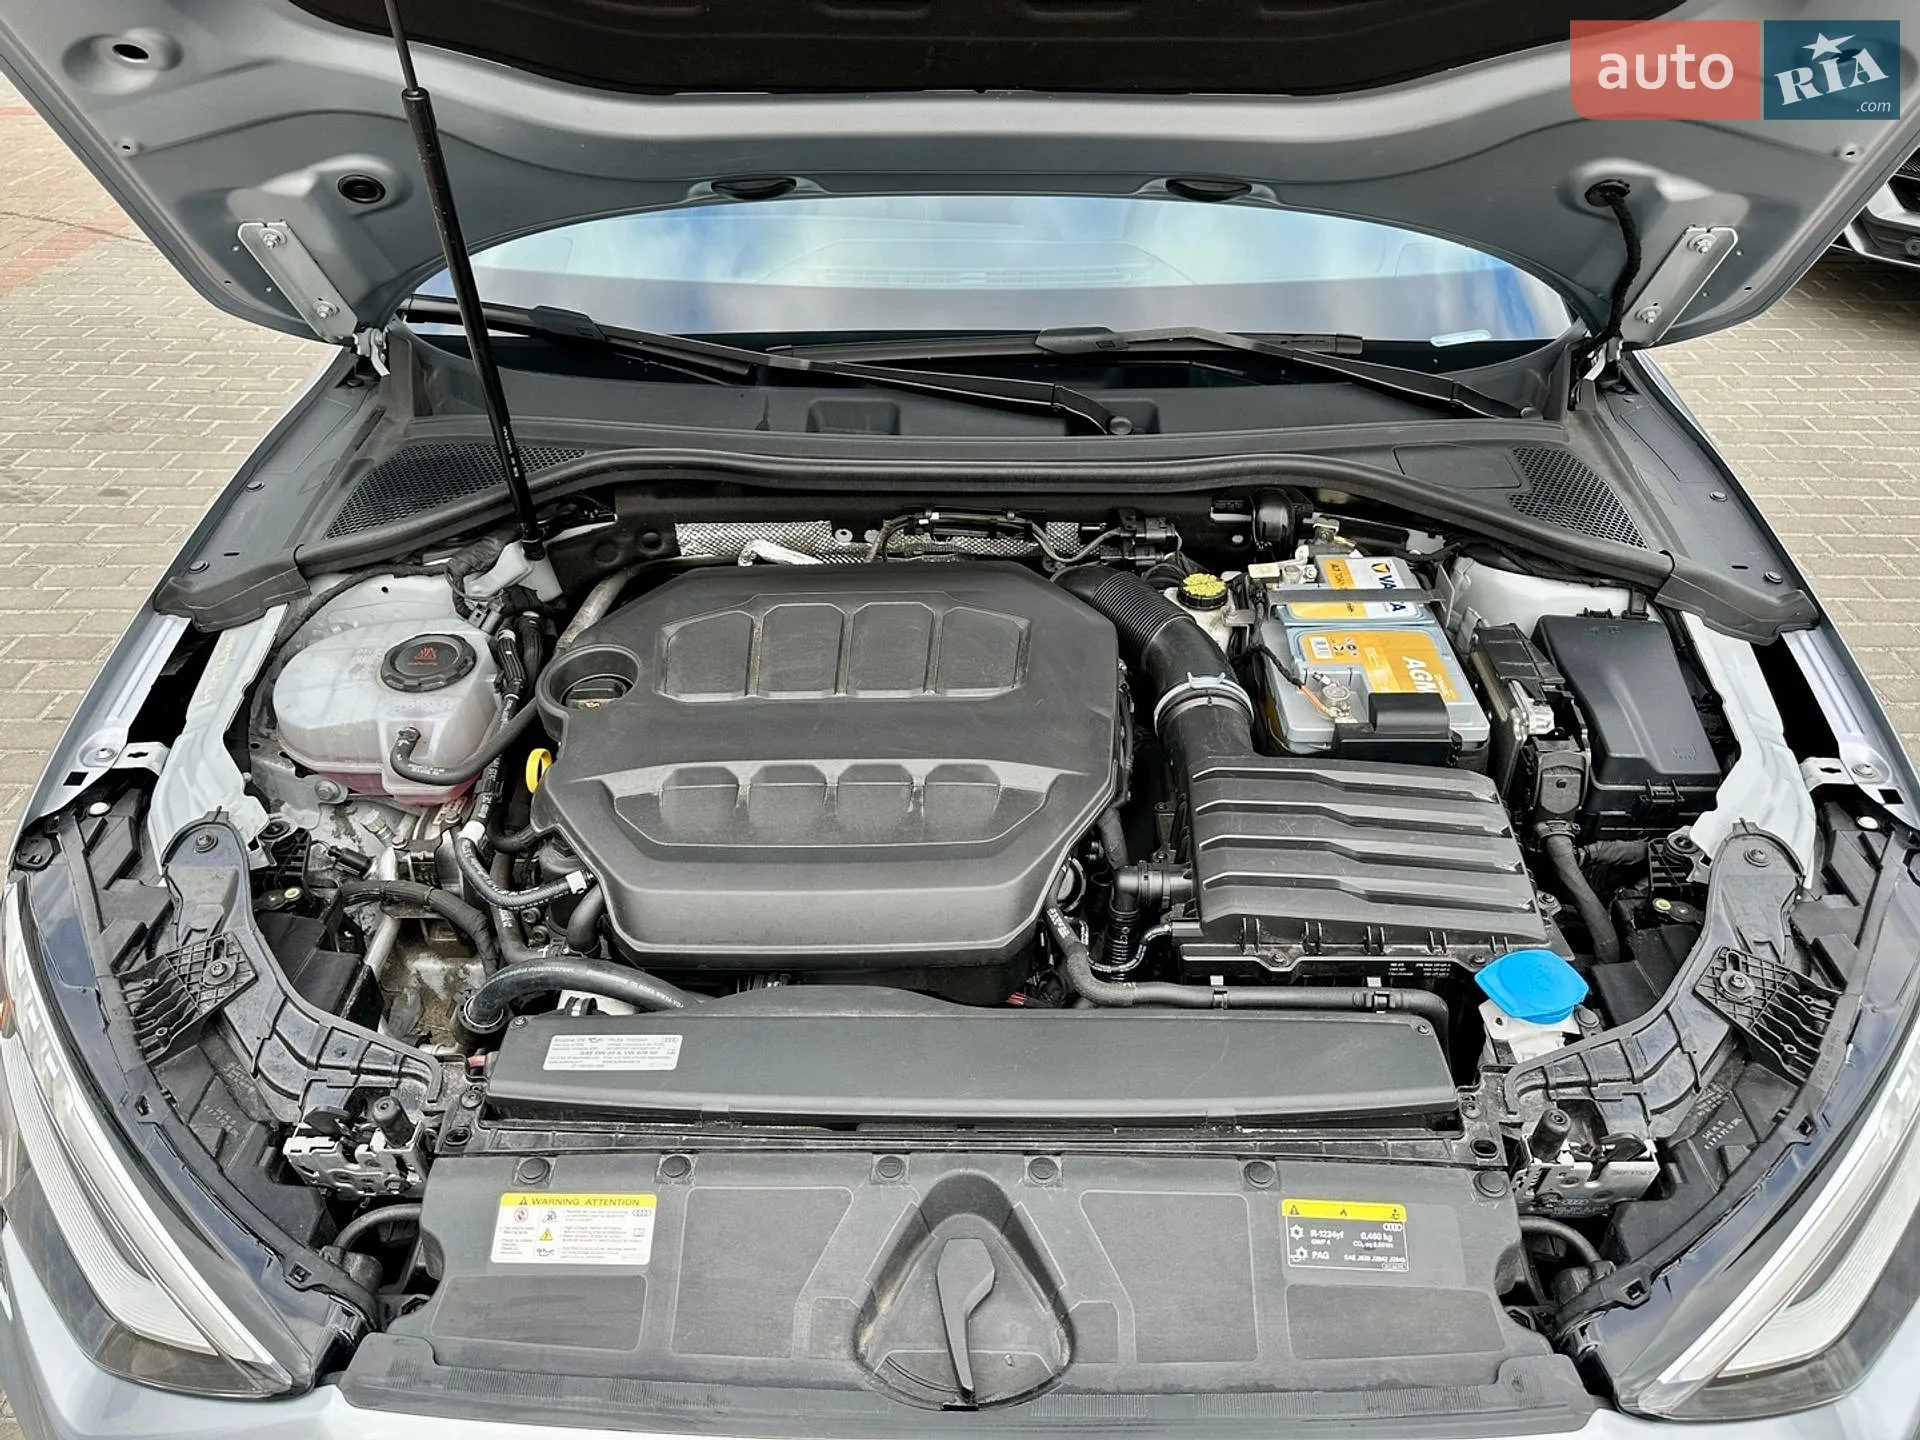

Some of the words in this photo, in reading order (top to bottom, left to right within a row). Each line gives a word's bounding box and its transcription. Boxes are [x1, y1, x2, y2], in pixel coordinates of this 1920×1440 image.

[531, 1197, 580, 1206] WARNING
[584, 1198, 640, 1206] ATTENTION
[1312, 1251, 1330, 1260] PAG
